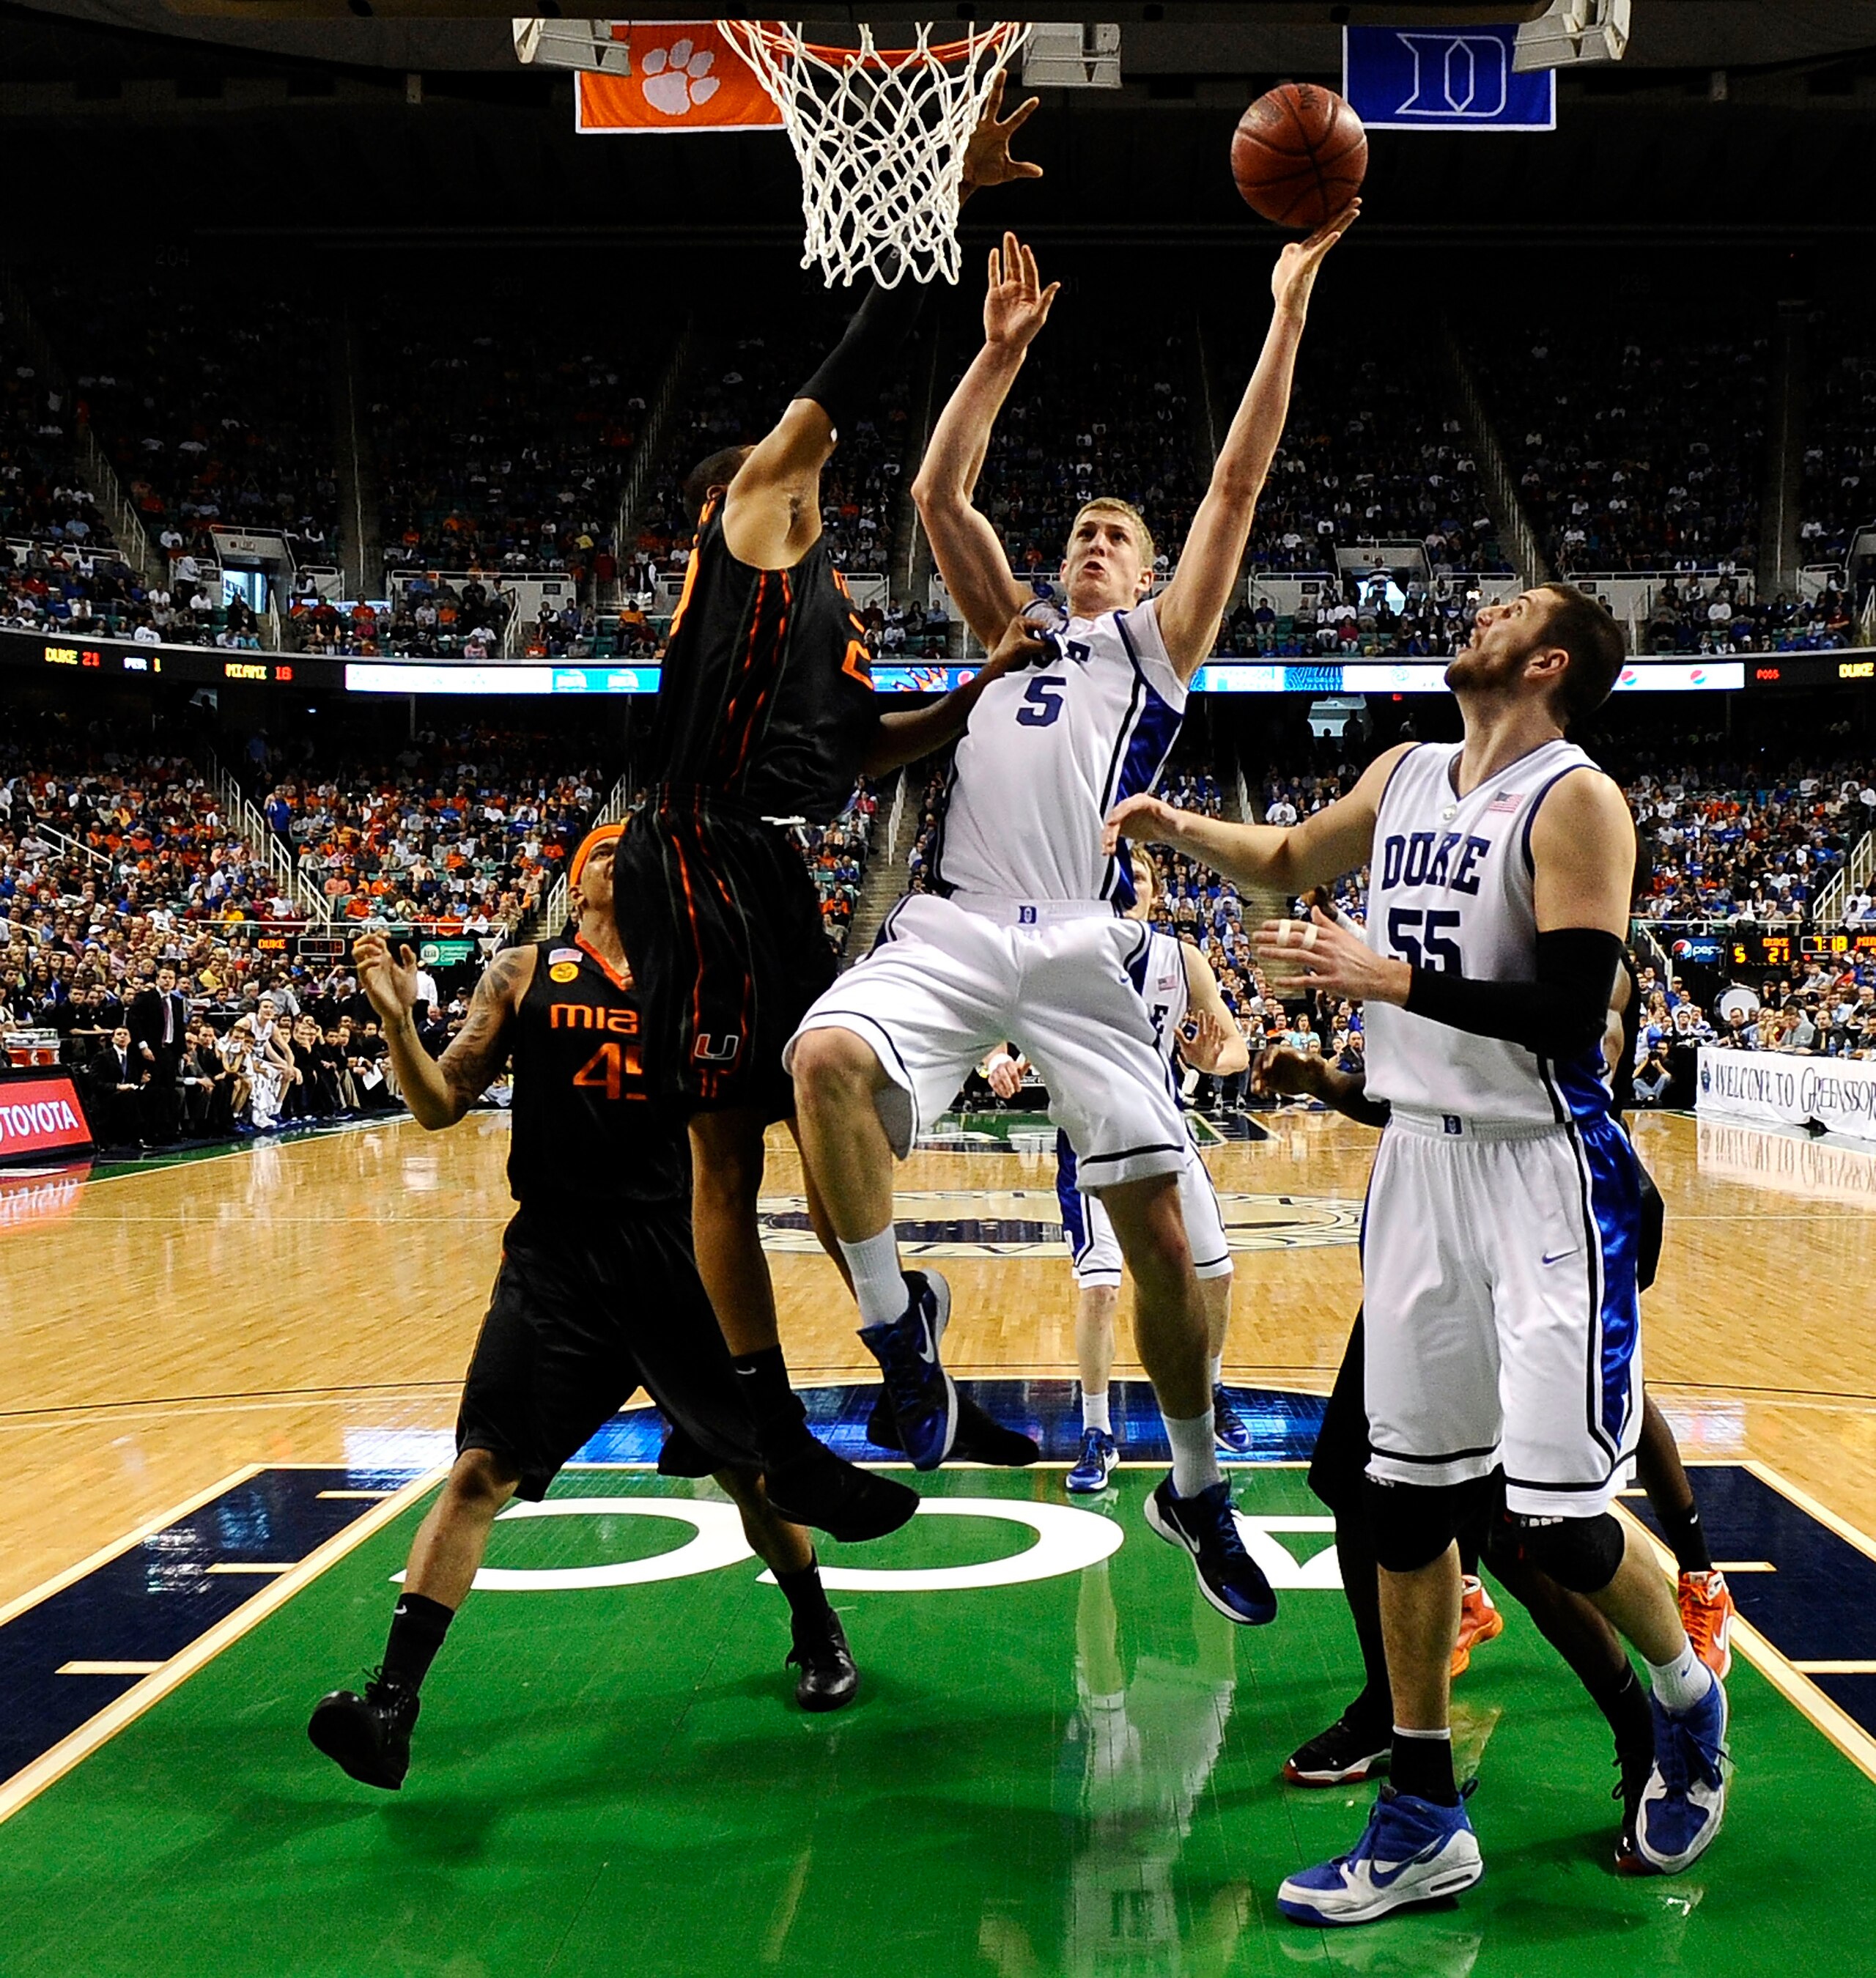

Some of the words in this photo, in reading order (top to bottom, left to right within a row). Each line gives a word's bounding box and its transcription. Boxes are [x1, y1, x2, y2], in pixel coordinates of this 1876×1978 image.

[45, 649, 78, 666] DUKE
[82, 653, 100, 668] 21
[225, 663, 267, 679] MIAMI
[1838, 663, 1875, 679] DUKE
[1016, 676, 1066, 727] 5
[1381, 831, 1492, 896] DUKE
[258, 940, 287, 951] DUKE
[1386, 907, 1462, 975] 55
[1812, 936, 1848, 953] 7:18
[1735, 948, 1746, 964] 5
[1768, 948, 1790, 964] 21
[1715, 1064, 1773, 1104] WELCOME
[1775, 1073, 1795, 1110] TO
[0, 1099, 79, 1137] TOYOTA
